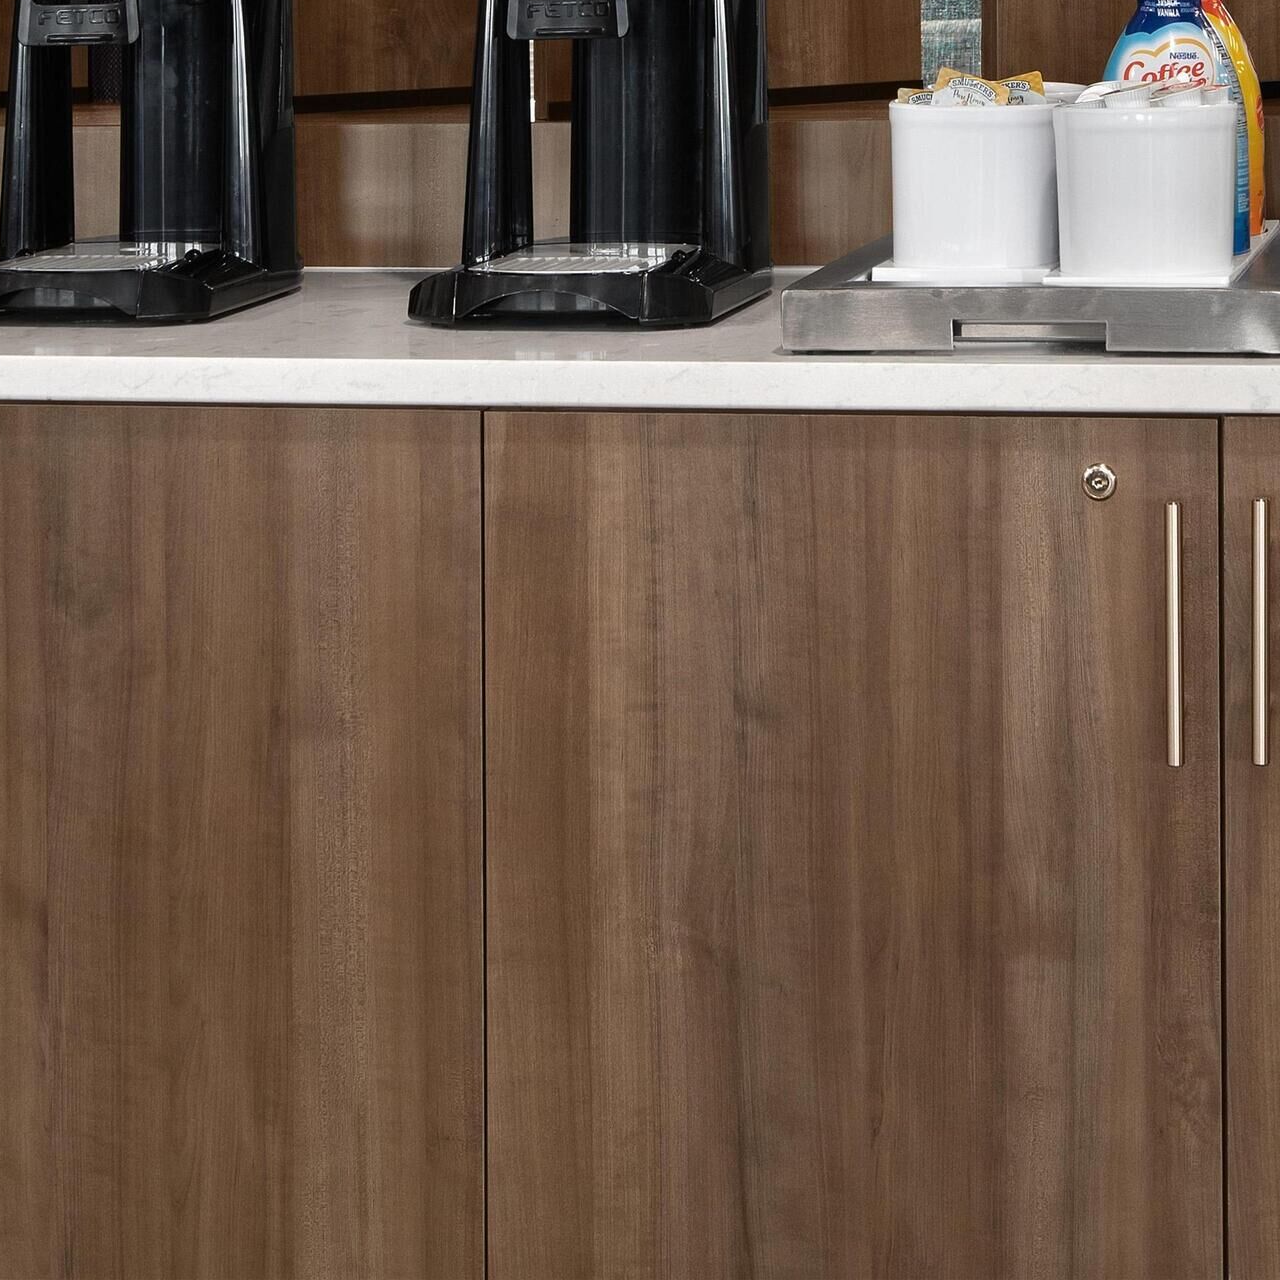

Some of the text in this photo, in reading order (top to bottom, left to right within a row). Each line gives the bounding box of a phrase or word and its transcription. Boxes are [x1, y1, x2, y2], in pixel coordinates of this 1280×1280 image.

[37, 8, 121, 26] FETCO
[526, 0, 611, 19] FETCO
[1156, 8, 1180, 17] VANILLA
[1123, 60, 1205, 83] Coffee
